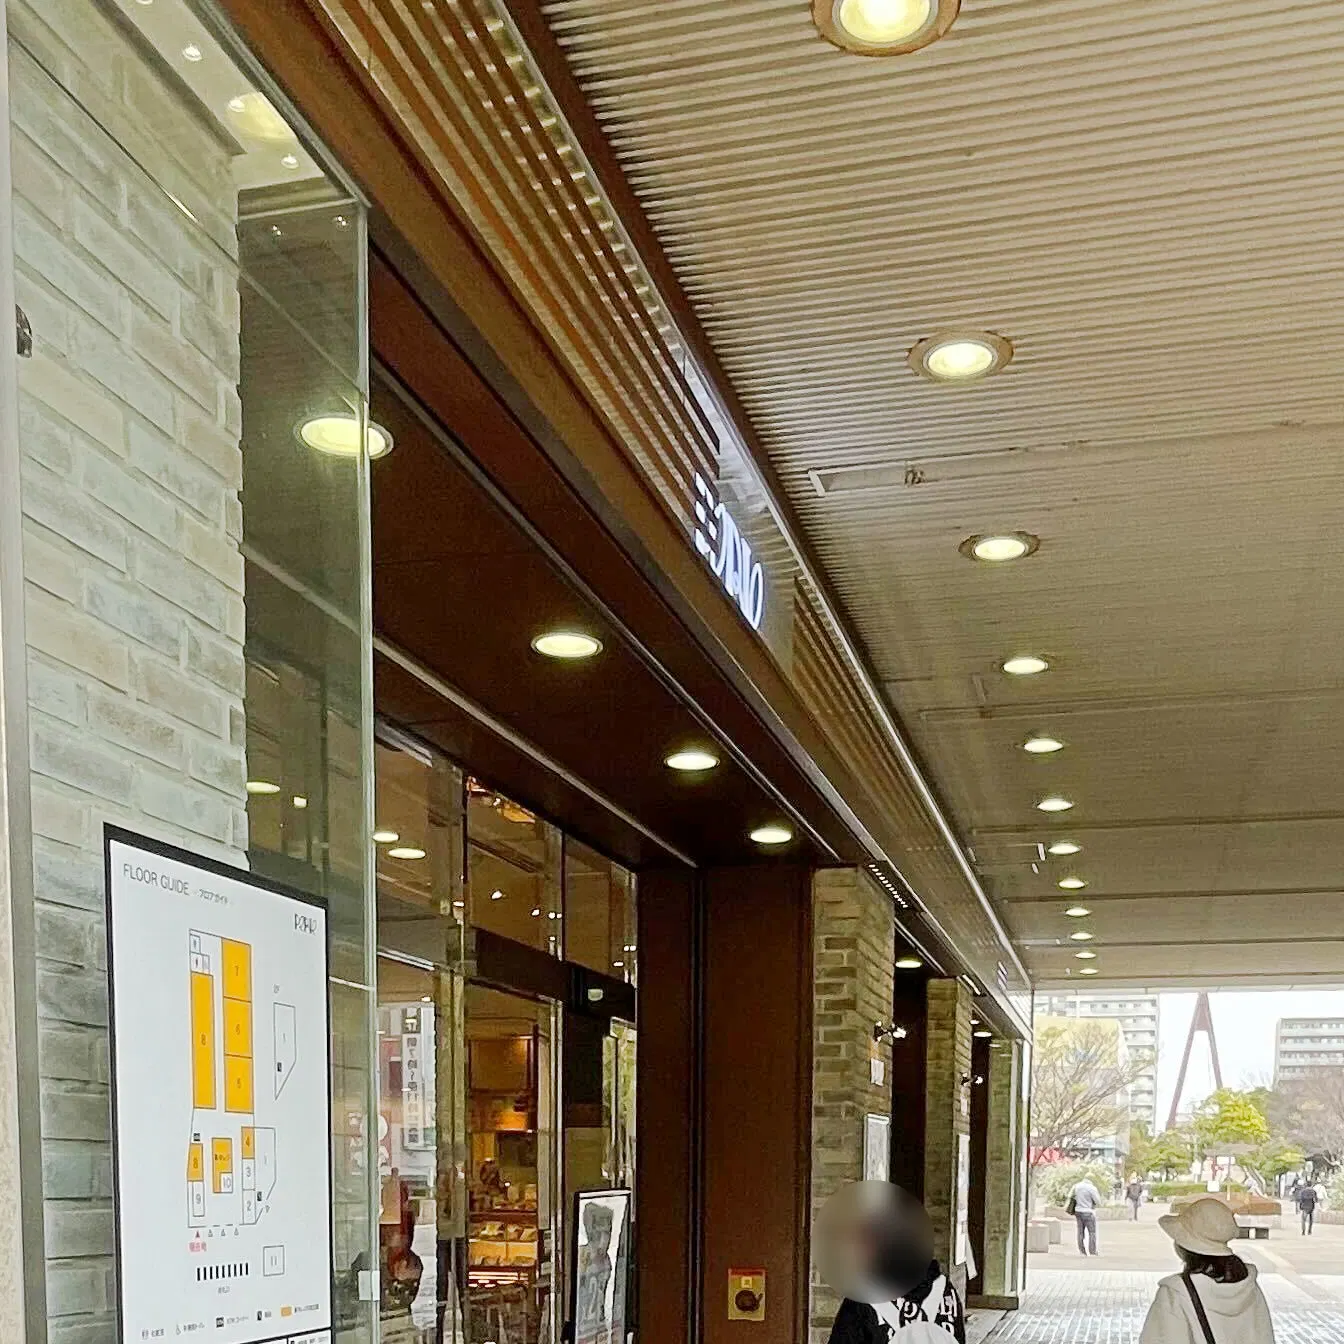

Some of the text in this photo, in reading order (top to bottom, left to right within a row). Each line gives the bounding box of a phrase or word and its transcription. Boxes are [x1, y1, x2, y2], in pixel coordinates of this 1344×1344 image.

[123, 863, 190, 896] FLOOR GUIDE
[200, 1033, 206, 1046] 8
[223, 1176, 232, 1189] 10
